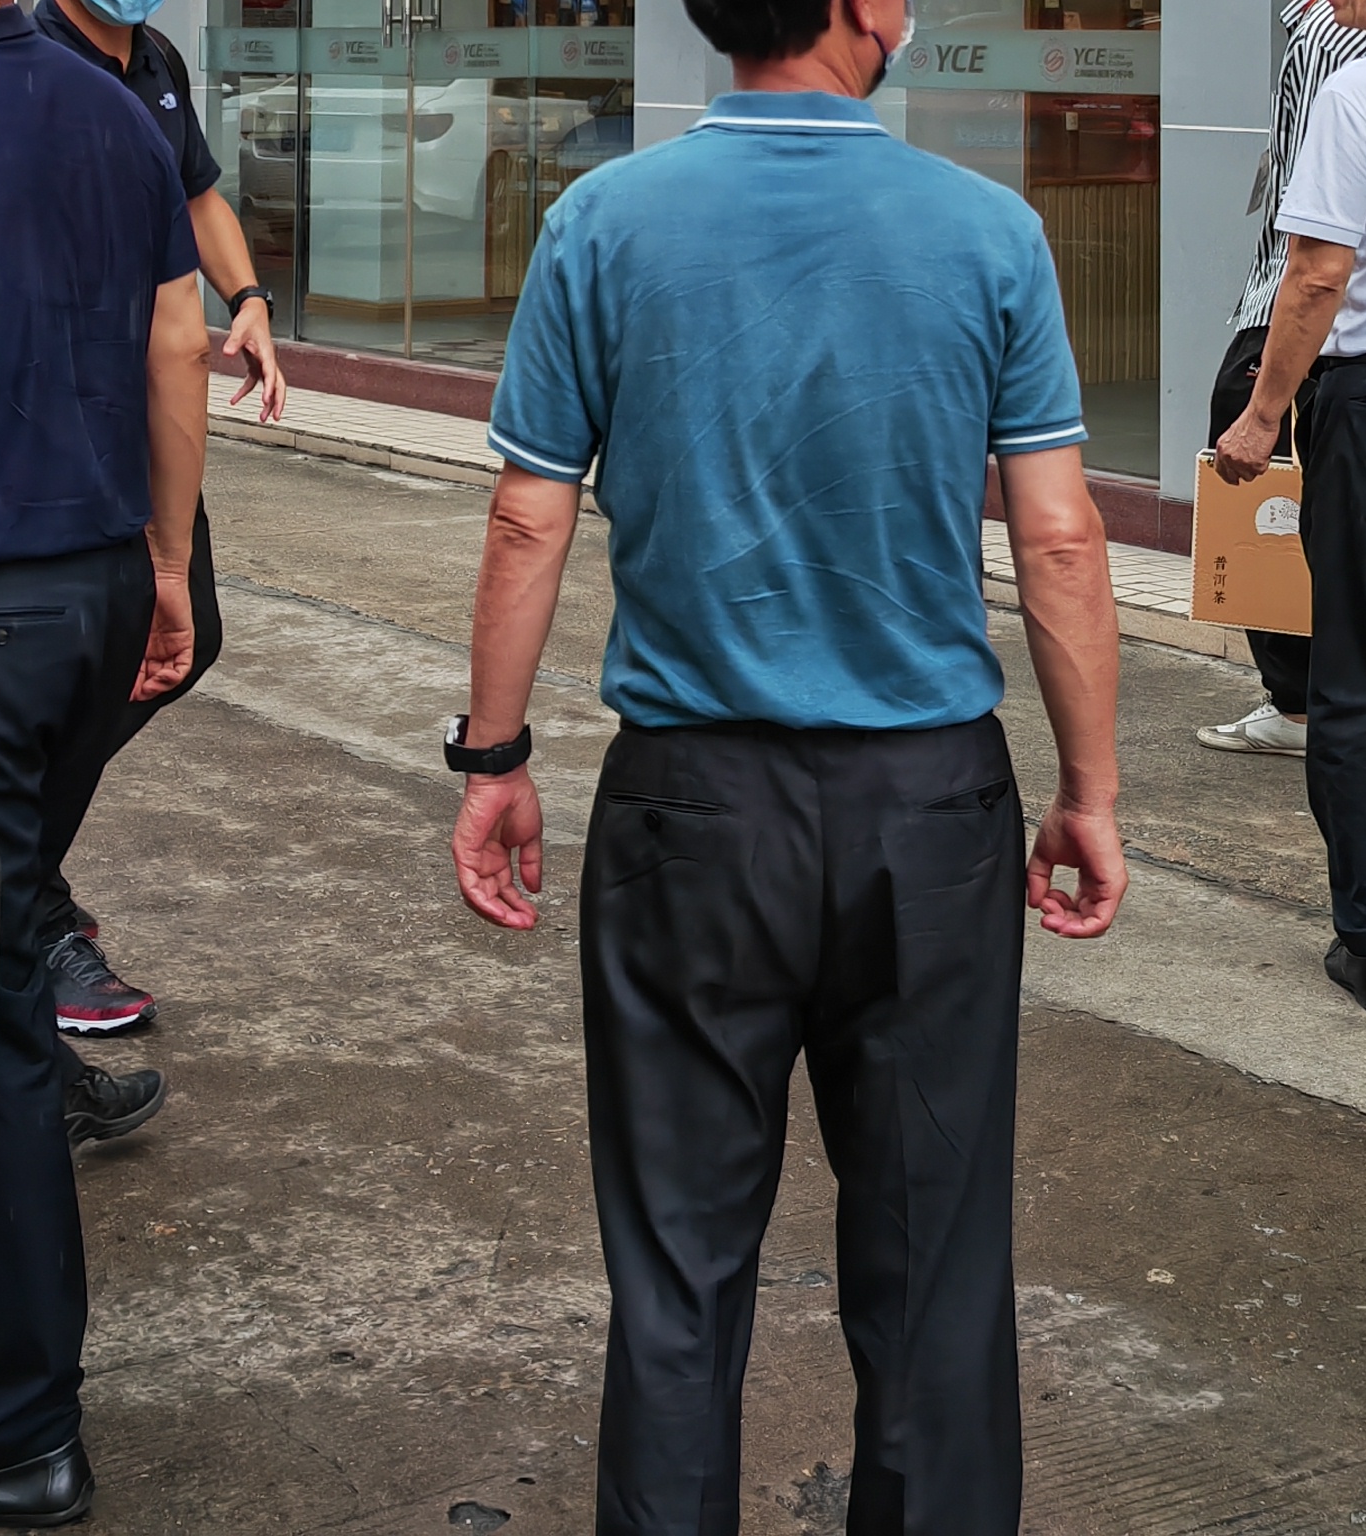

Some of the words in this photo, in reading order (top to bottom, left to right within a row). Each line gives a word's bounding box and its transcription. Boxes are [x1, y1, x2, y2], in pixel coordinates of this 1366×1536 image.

[584, 41, 606, 55] YCE
[1073, 48, 1106, 65] YCE
[936, 45, 987, 73] YCE
